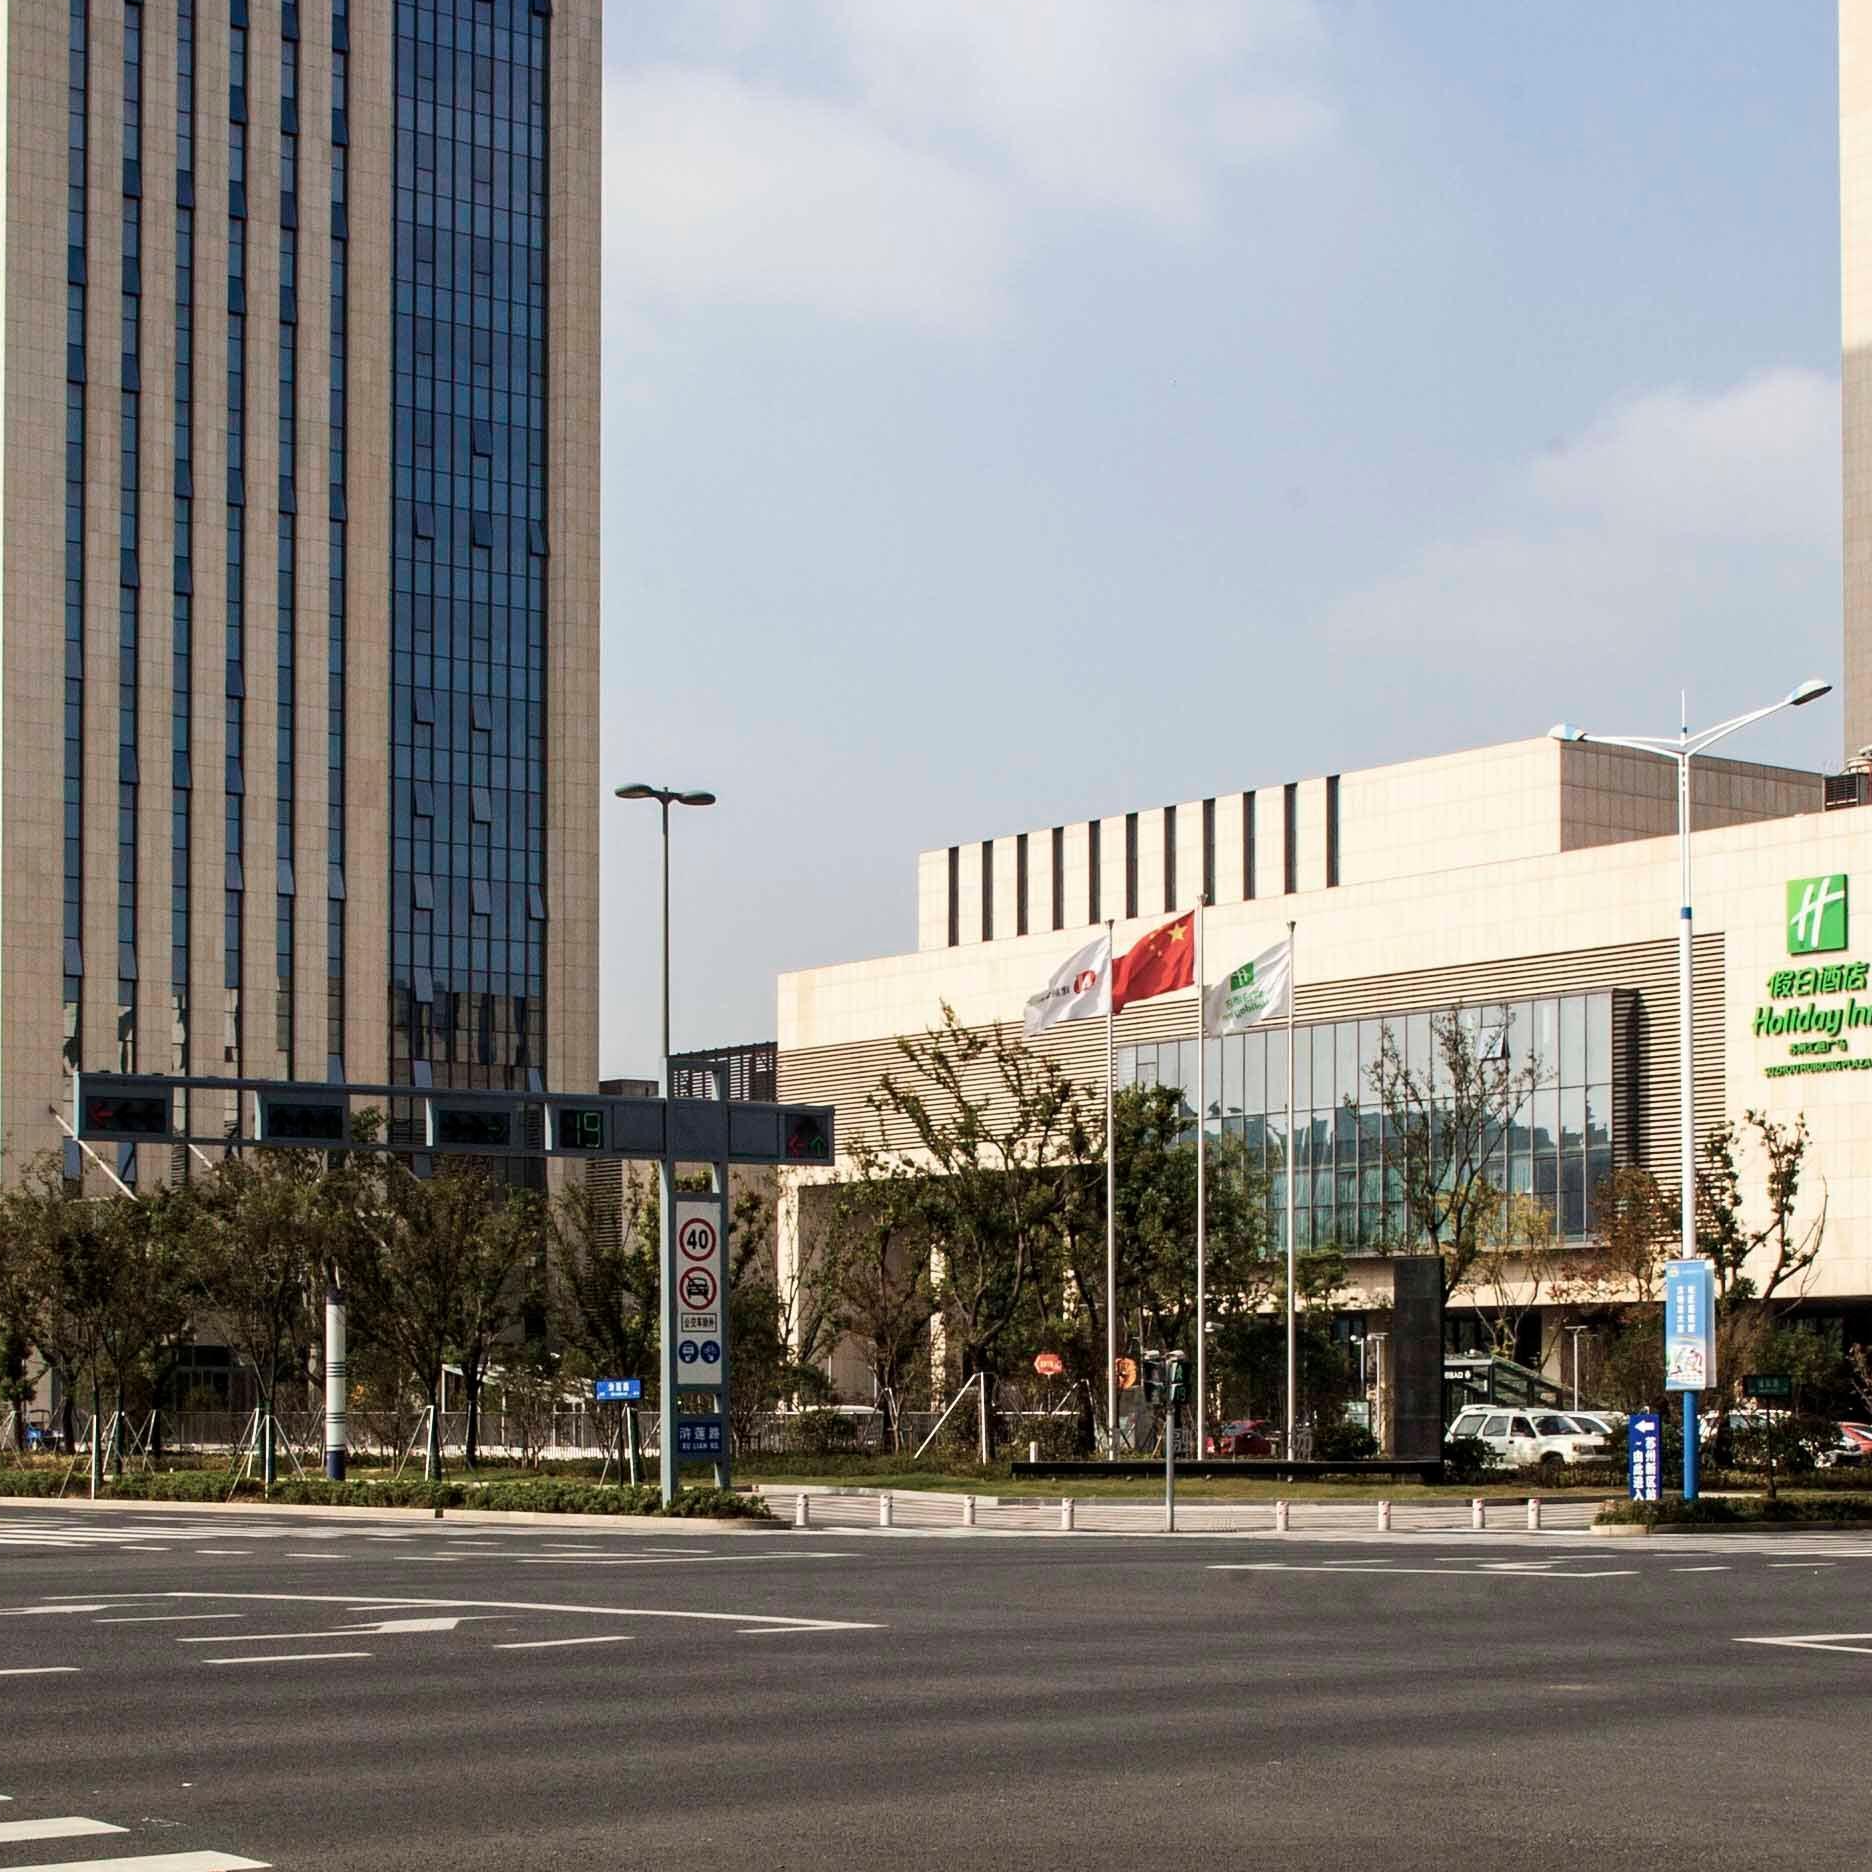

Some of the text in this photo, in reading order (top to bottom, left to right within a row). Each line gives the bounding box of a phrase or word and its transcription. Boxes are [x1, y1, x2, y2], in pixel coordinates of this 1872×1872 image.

[1767, 961, 1870, 999] 假日酒店
[1753, 1002, 1844, 1037] Holiday
[687, 1229, 709, 1249] 40
